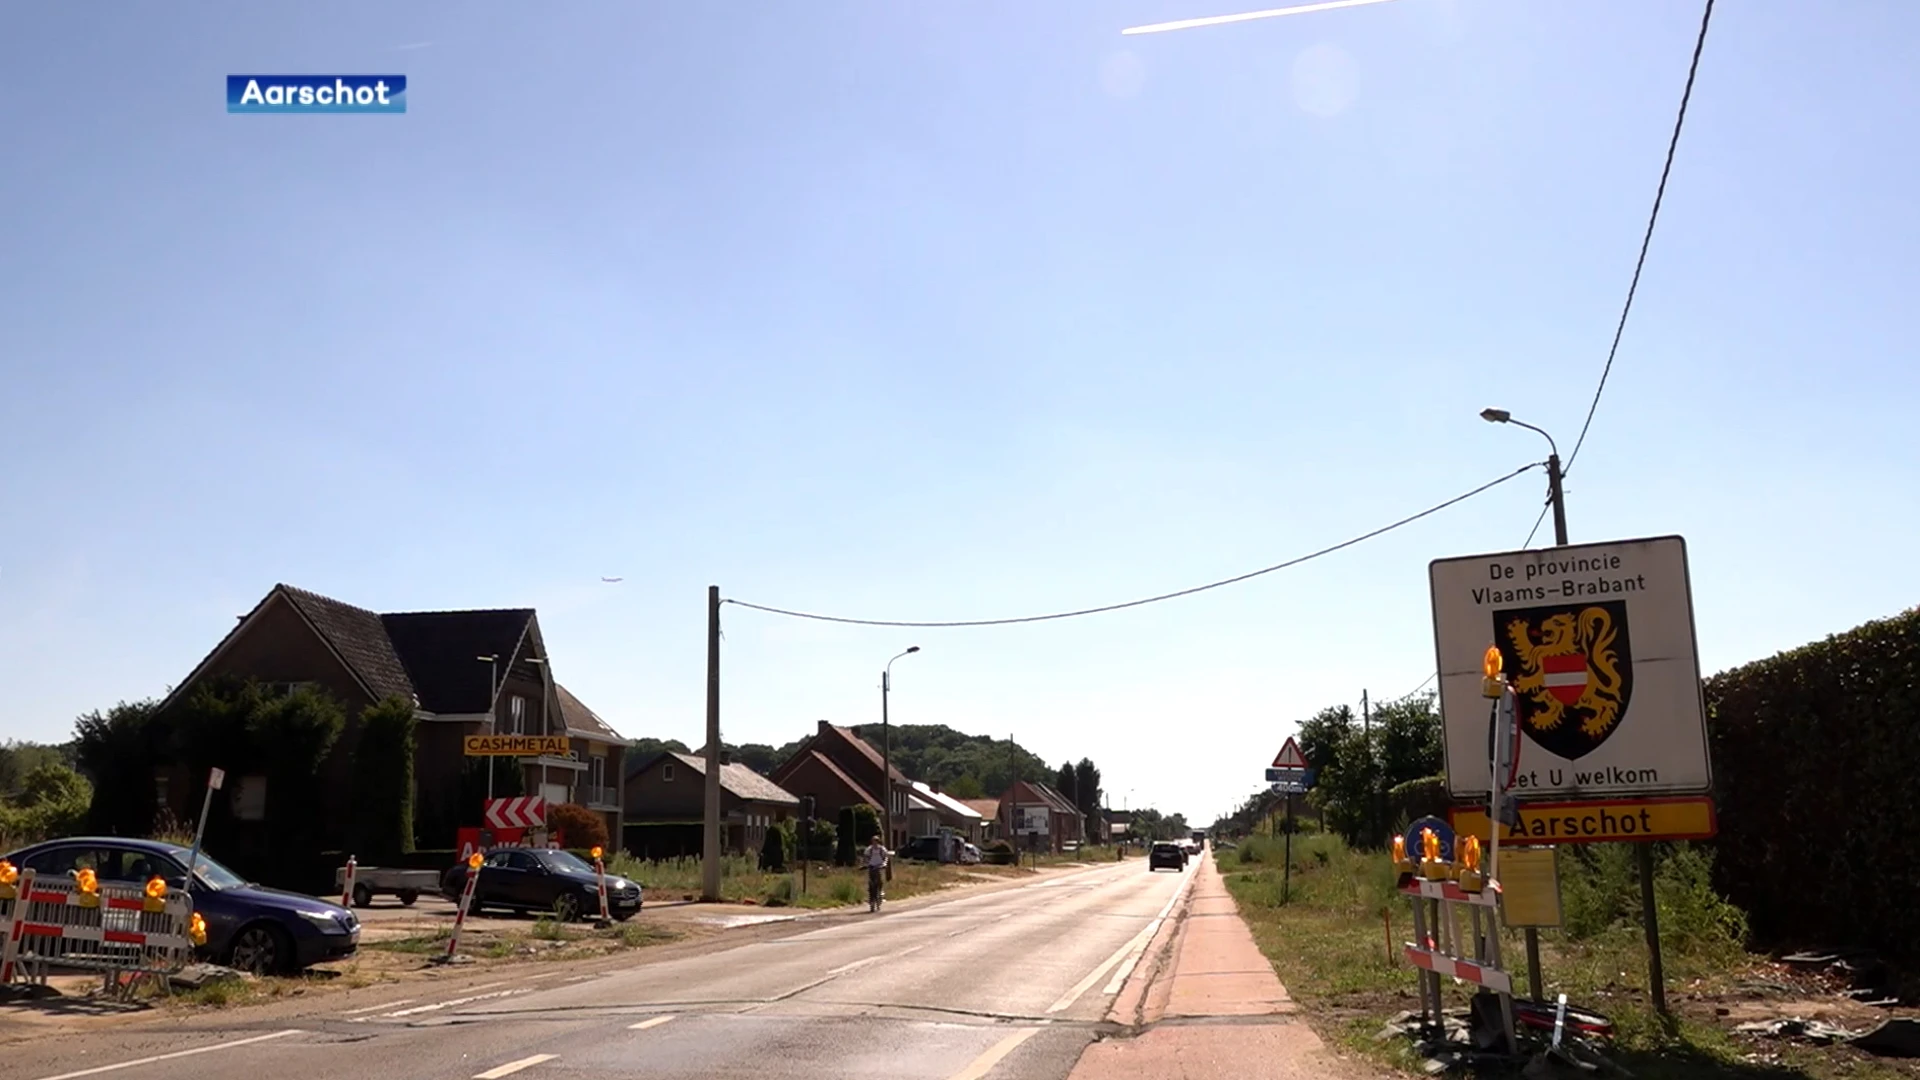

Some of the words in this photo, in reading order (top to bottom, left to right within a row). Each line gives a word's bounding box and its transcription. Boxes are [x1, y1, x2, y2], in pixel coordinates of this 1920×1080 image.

[1489, 563, 1515, 580] De
[1526, 553, 1621, 581] provincie
[1472, 574, 1646, 605] Vlaams-Brabant
[467, 737, 567, 751] CASHMETAL
[1550, 768, 1563, 786] U
[1575, 766, 1659, 785] welkom
[1509, 808, 1652, 837] Aarschot
